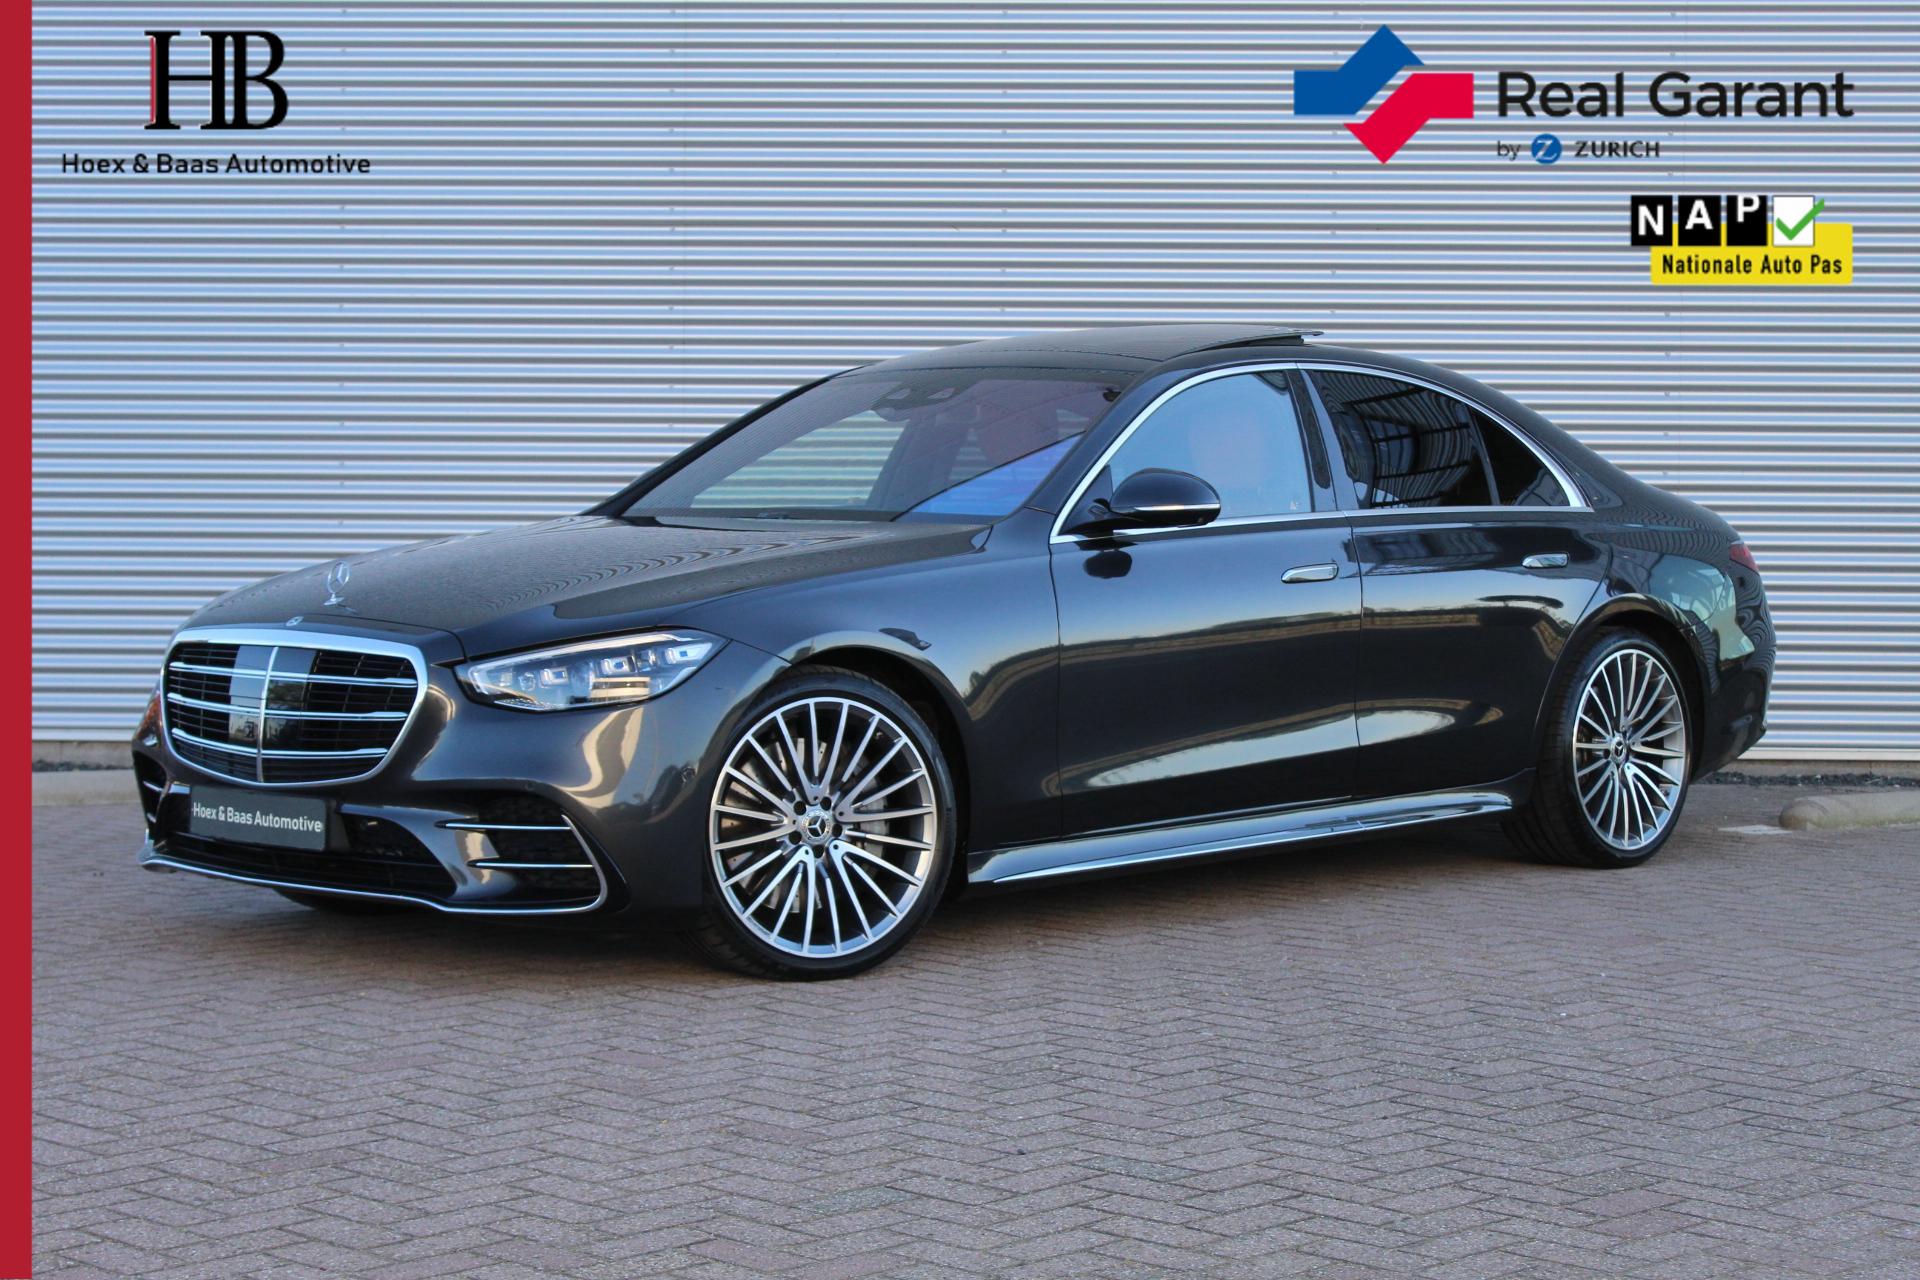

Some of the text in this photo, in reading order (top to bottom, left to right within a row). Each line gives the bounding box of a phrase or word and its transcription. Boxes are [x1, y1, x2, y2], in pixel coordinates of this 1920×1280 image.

[193, 803, 322, 832] Hoex & Baas Automotive
